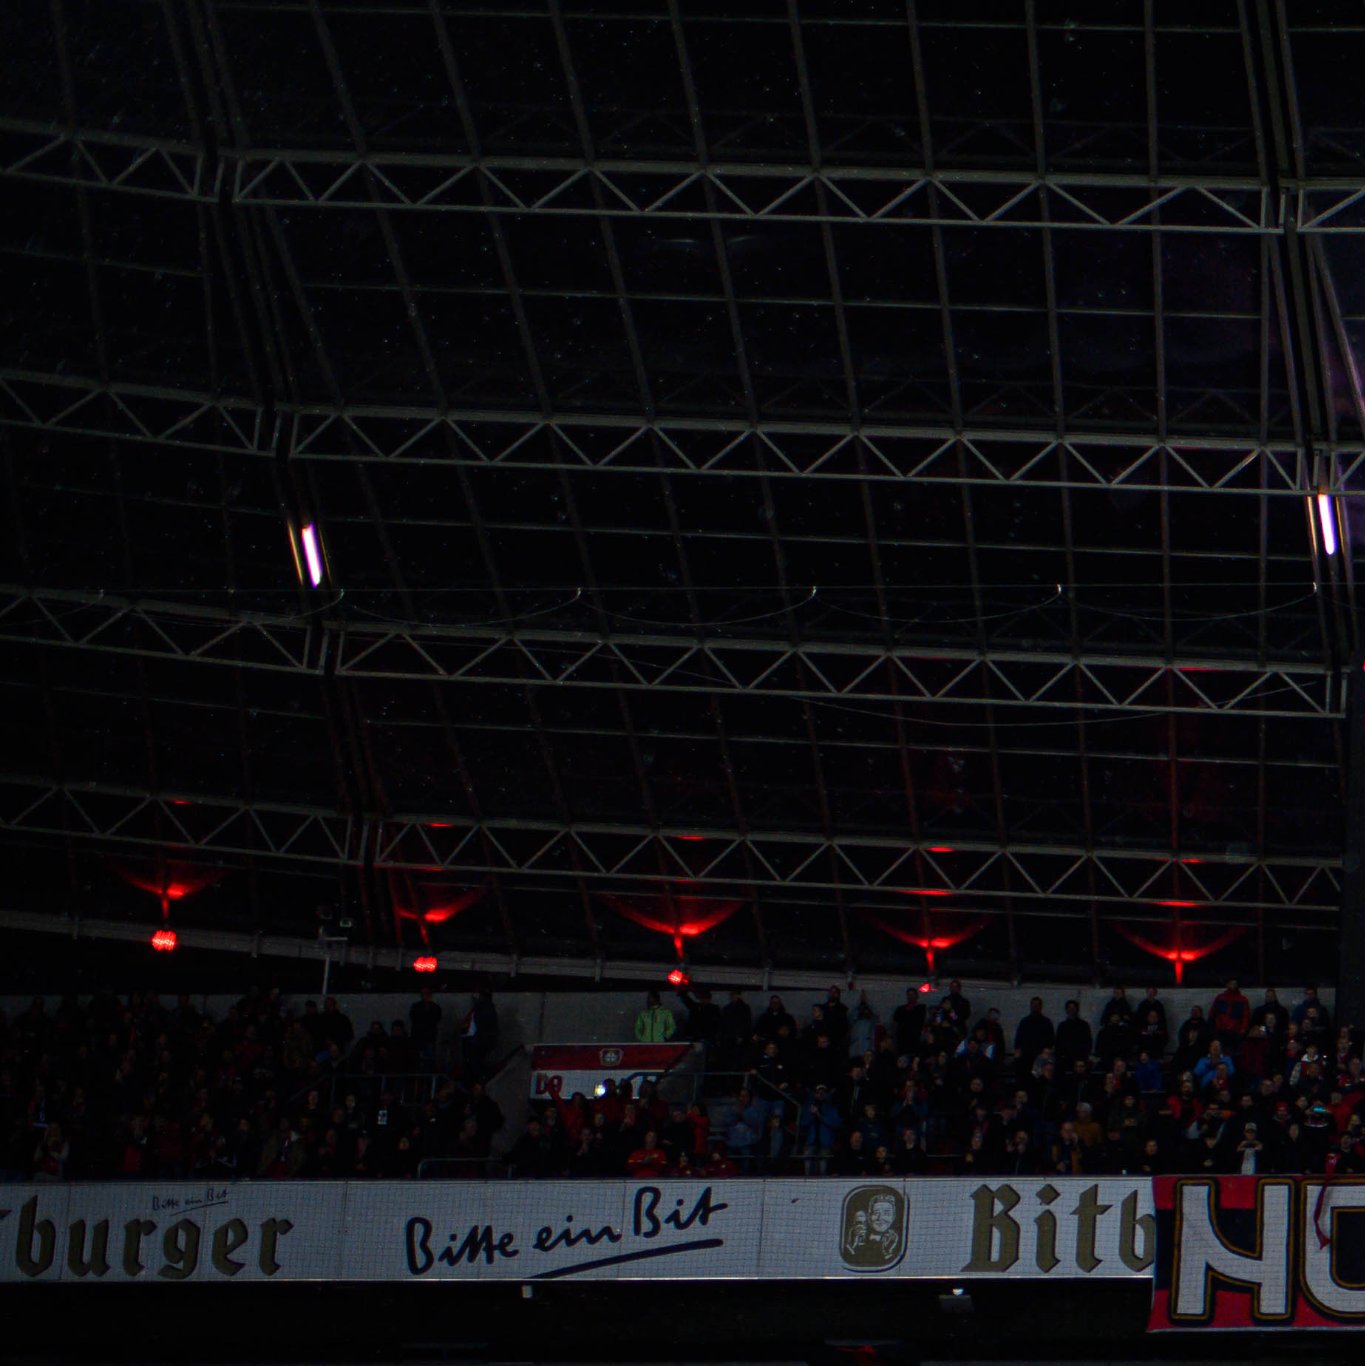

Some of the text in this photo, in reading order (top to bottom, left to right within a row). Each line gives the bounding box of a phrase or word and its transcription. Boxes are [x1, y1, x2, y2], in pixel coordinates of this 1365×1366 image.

[0, 1194, 294, 1279] burger
[405, 1186, 731, 1276] Bitte ein Bit
